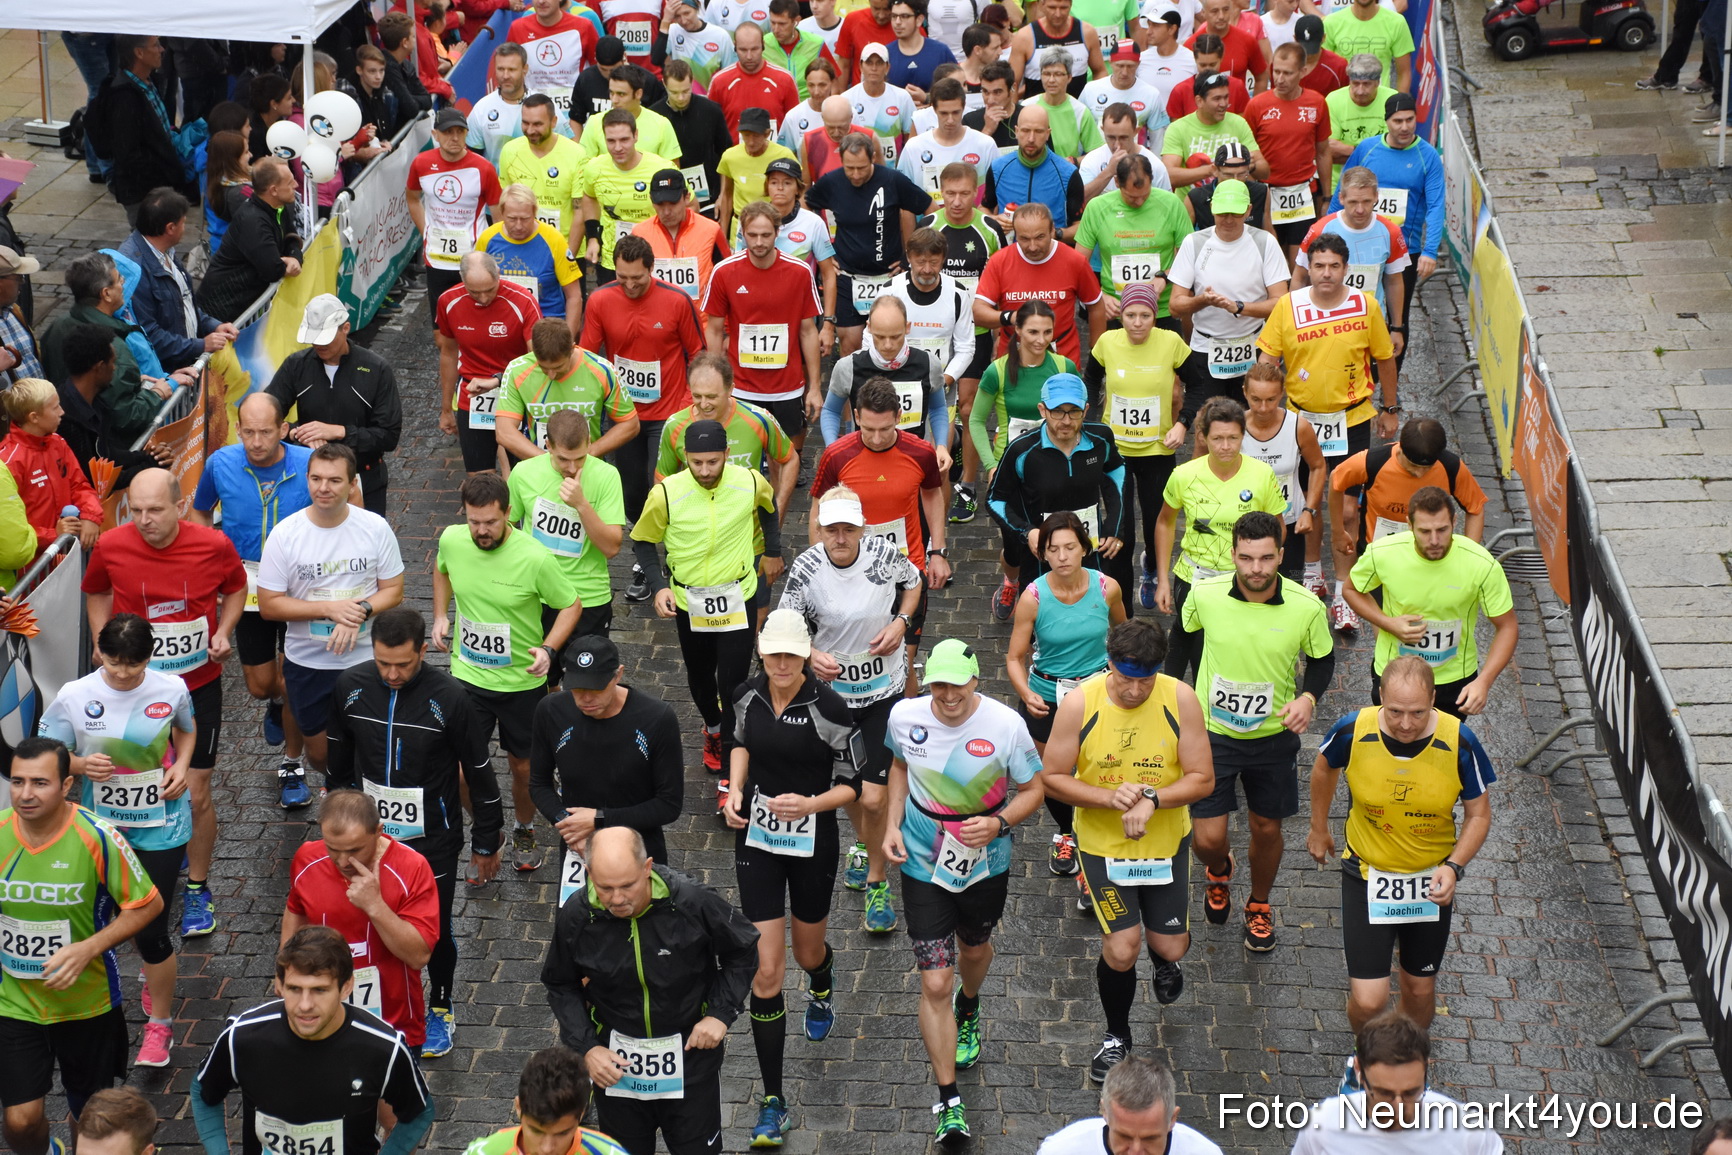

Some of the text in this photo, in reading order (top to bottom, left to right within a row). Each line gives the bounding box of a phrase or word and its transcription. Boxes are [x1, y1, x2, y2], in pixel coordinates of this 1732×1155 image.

[620, 30, 649, 43] 2089
[550, 96, 572, 109] 55
[1279, 192, 1305, 209] 204
[875, 209, 885, 262] RAILONE
[440, 238, 458, 254] 78
[947, 258, 966, 267] DAV
[656, 267, 695, 285] 3106
[1122, 264, 1151, 281] 612
[1005, 290, 1058, 302] NEUMARKT
[1297, 320, 1368, 344] MAX BÖGL
[749, 335, 780, 353] 117
[753, 354, 776, 364] Martin
[1213, 344, 1253, 364] 2428
[1218, 363, 1248, 374] Reinhard
[618, 366, 656, 388] 2896
[1119, 408, 1151, 426] 134
[1124, 428, 1144, 437] Anika
[536, 510, 582, 540] 2008
[704, 595, 728, 615] 80
[706, 617, 731, 626] Tobias
[152, 631, 206, 657] 2537
[462, 627, 505, 654] 2248
[159, 655, 199, 671] Johannes
[467, 650, 499, 665] Christian
[837, 656, 884, 682] 2090
[851, 682, 872, 693] Erich
[1214, 689, 1267, 715] 2572
[147, 705, 170, 716] Hervis
[782, 714, 808, 724] FALKE
[1230, 715, 1248, 727] Fabi
[907, 745, 928, 755] PARTL
[967, 740, 994, 755] Hervis
[100, 784, 160, 808] 2378
[109, 809, 149, 822] Krystyna
[371, 795, 418, 824] 629
[764, 833, 797, 848] Daniela
[1127, 867, 1153, 878] Alfred
[0, 880, 85, 906] BOCK
[1376, 876, 1432, 902] 2815
[1384, 903, 1424, 917] Joachim
[2, 929, 65, 958] 2825
[615, 1048, 677, 1078] 2358
[631, 1079, 658, 1092] Josef
[264, 1131, 335, 1155] 2854
